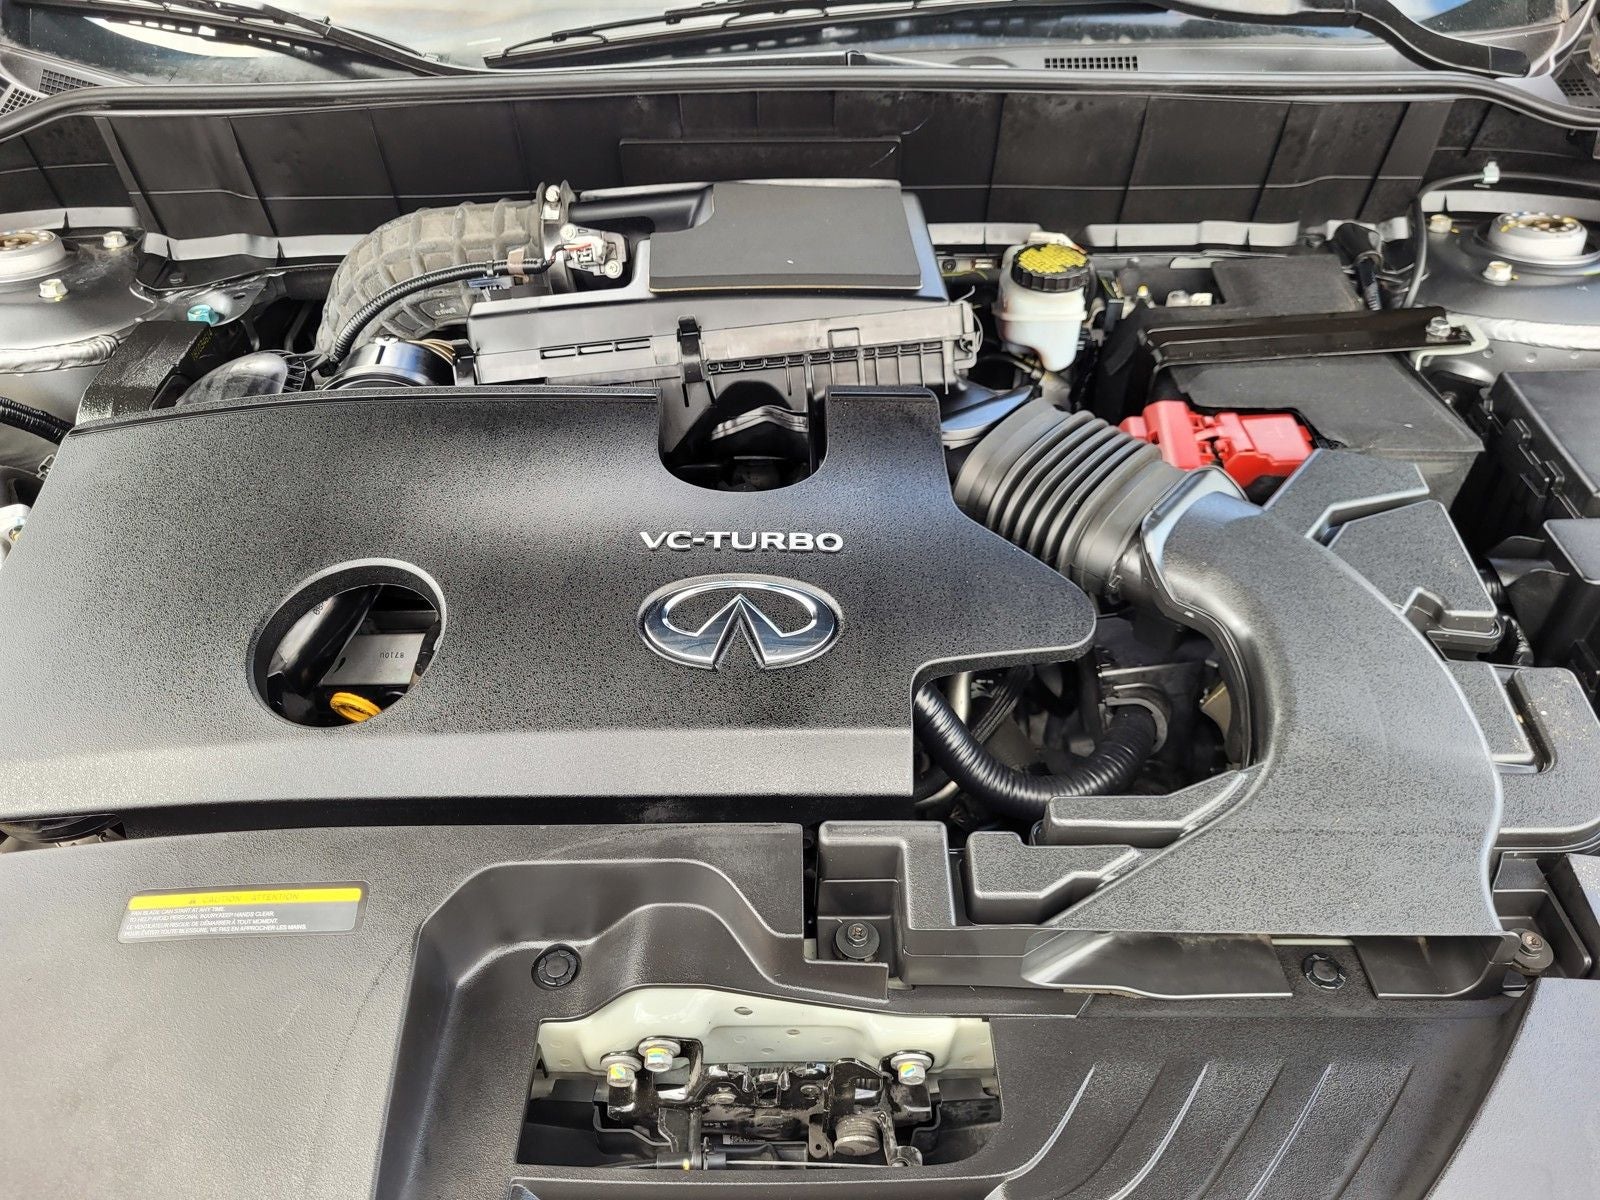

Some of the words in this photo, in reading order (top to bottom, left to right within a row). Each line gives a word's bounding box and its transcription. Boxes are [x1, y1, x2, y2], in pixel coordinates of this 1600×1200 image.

[639, 530, 844, 552] VC-TURBO
[202, 894, 241, 904] CAUTION
[251, 892, 298, 901] ATTENTION
